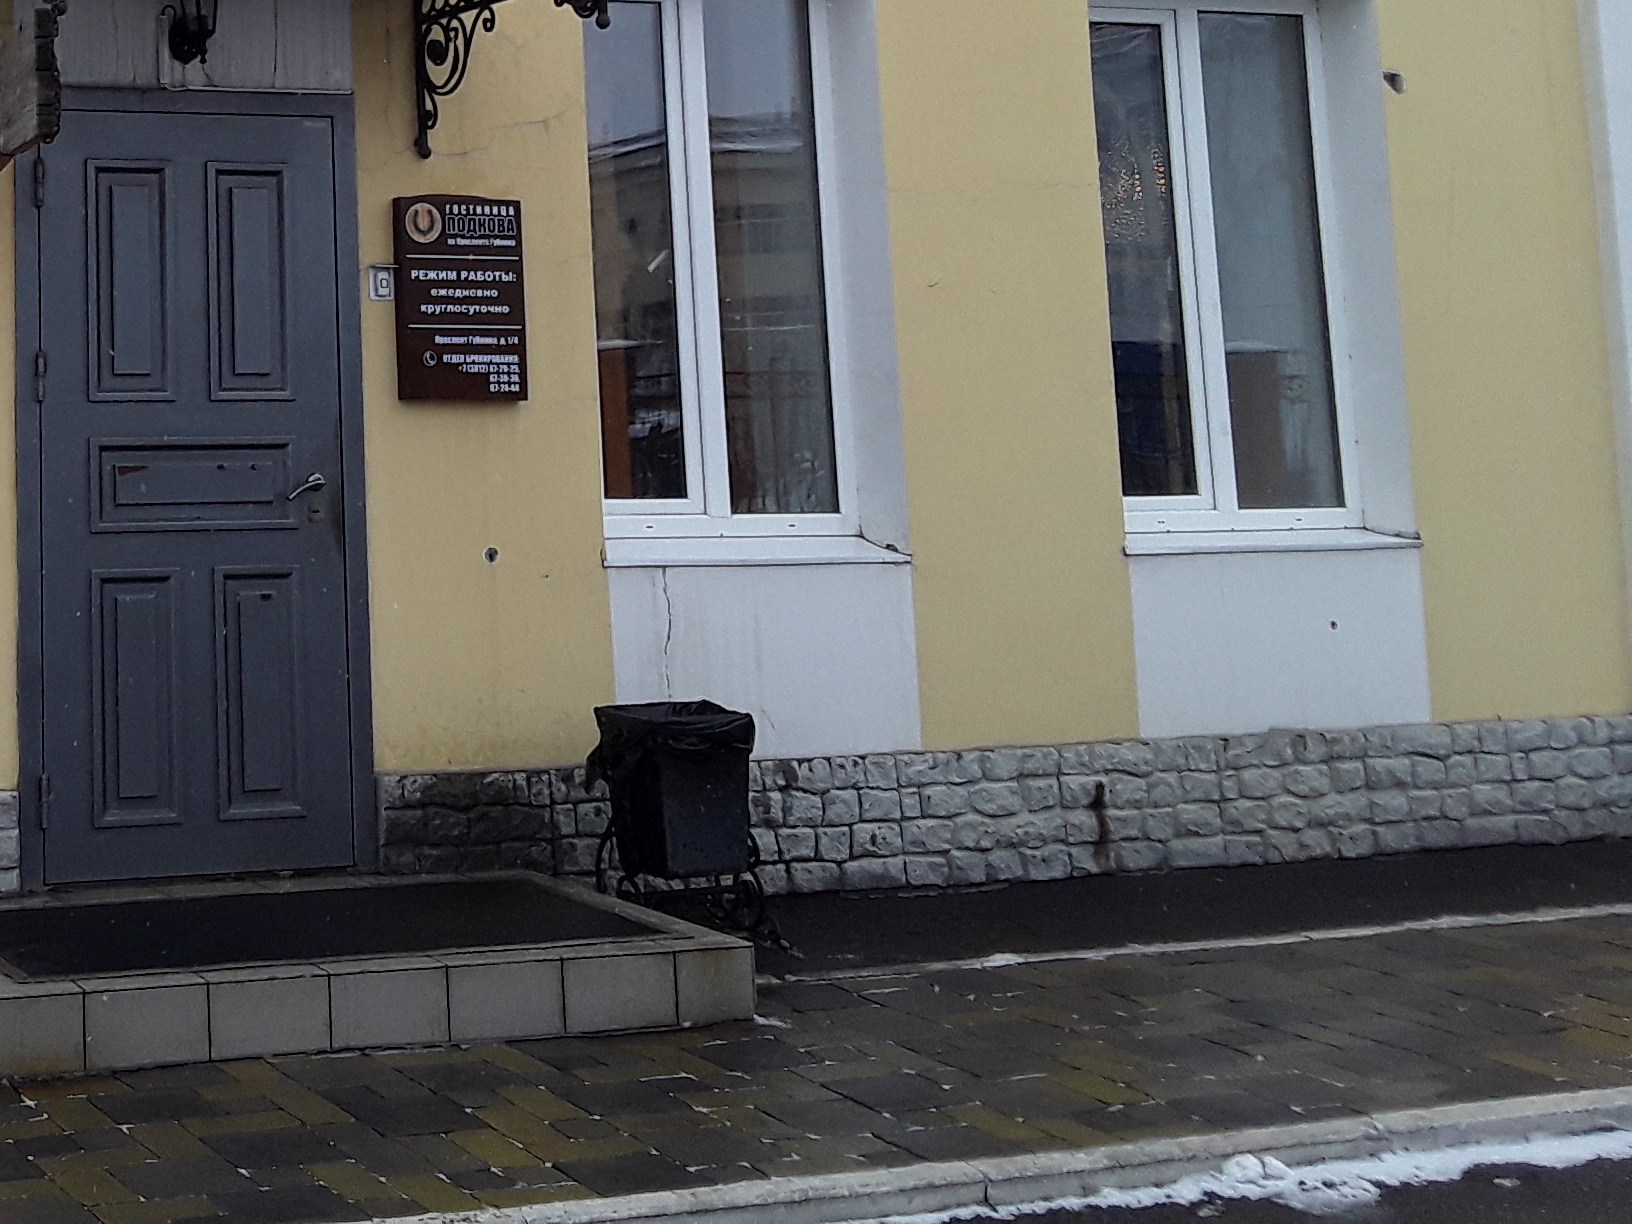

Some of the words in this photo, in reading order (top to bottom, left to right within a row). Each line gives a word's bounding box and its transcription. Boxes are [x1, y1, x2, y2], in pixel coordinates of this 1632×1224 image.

[445, 204, 515, 216] ГОСТИНИЦА
[445, 215, 517, 236] ПОДКОВА
[410, 269, 458, 281] РЕЖИМ
[460, 270, 517, 282] РАБОТЫ:
[430, 288, 499, 298] ежедневно
[420, 304, 510, 315] круглосуточно
